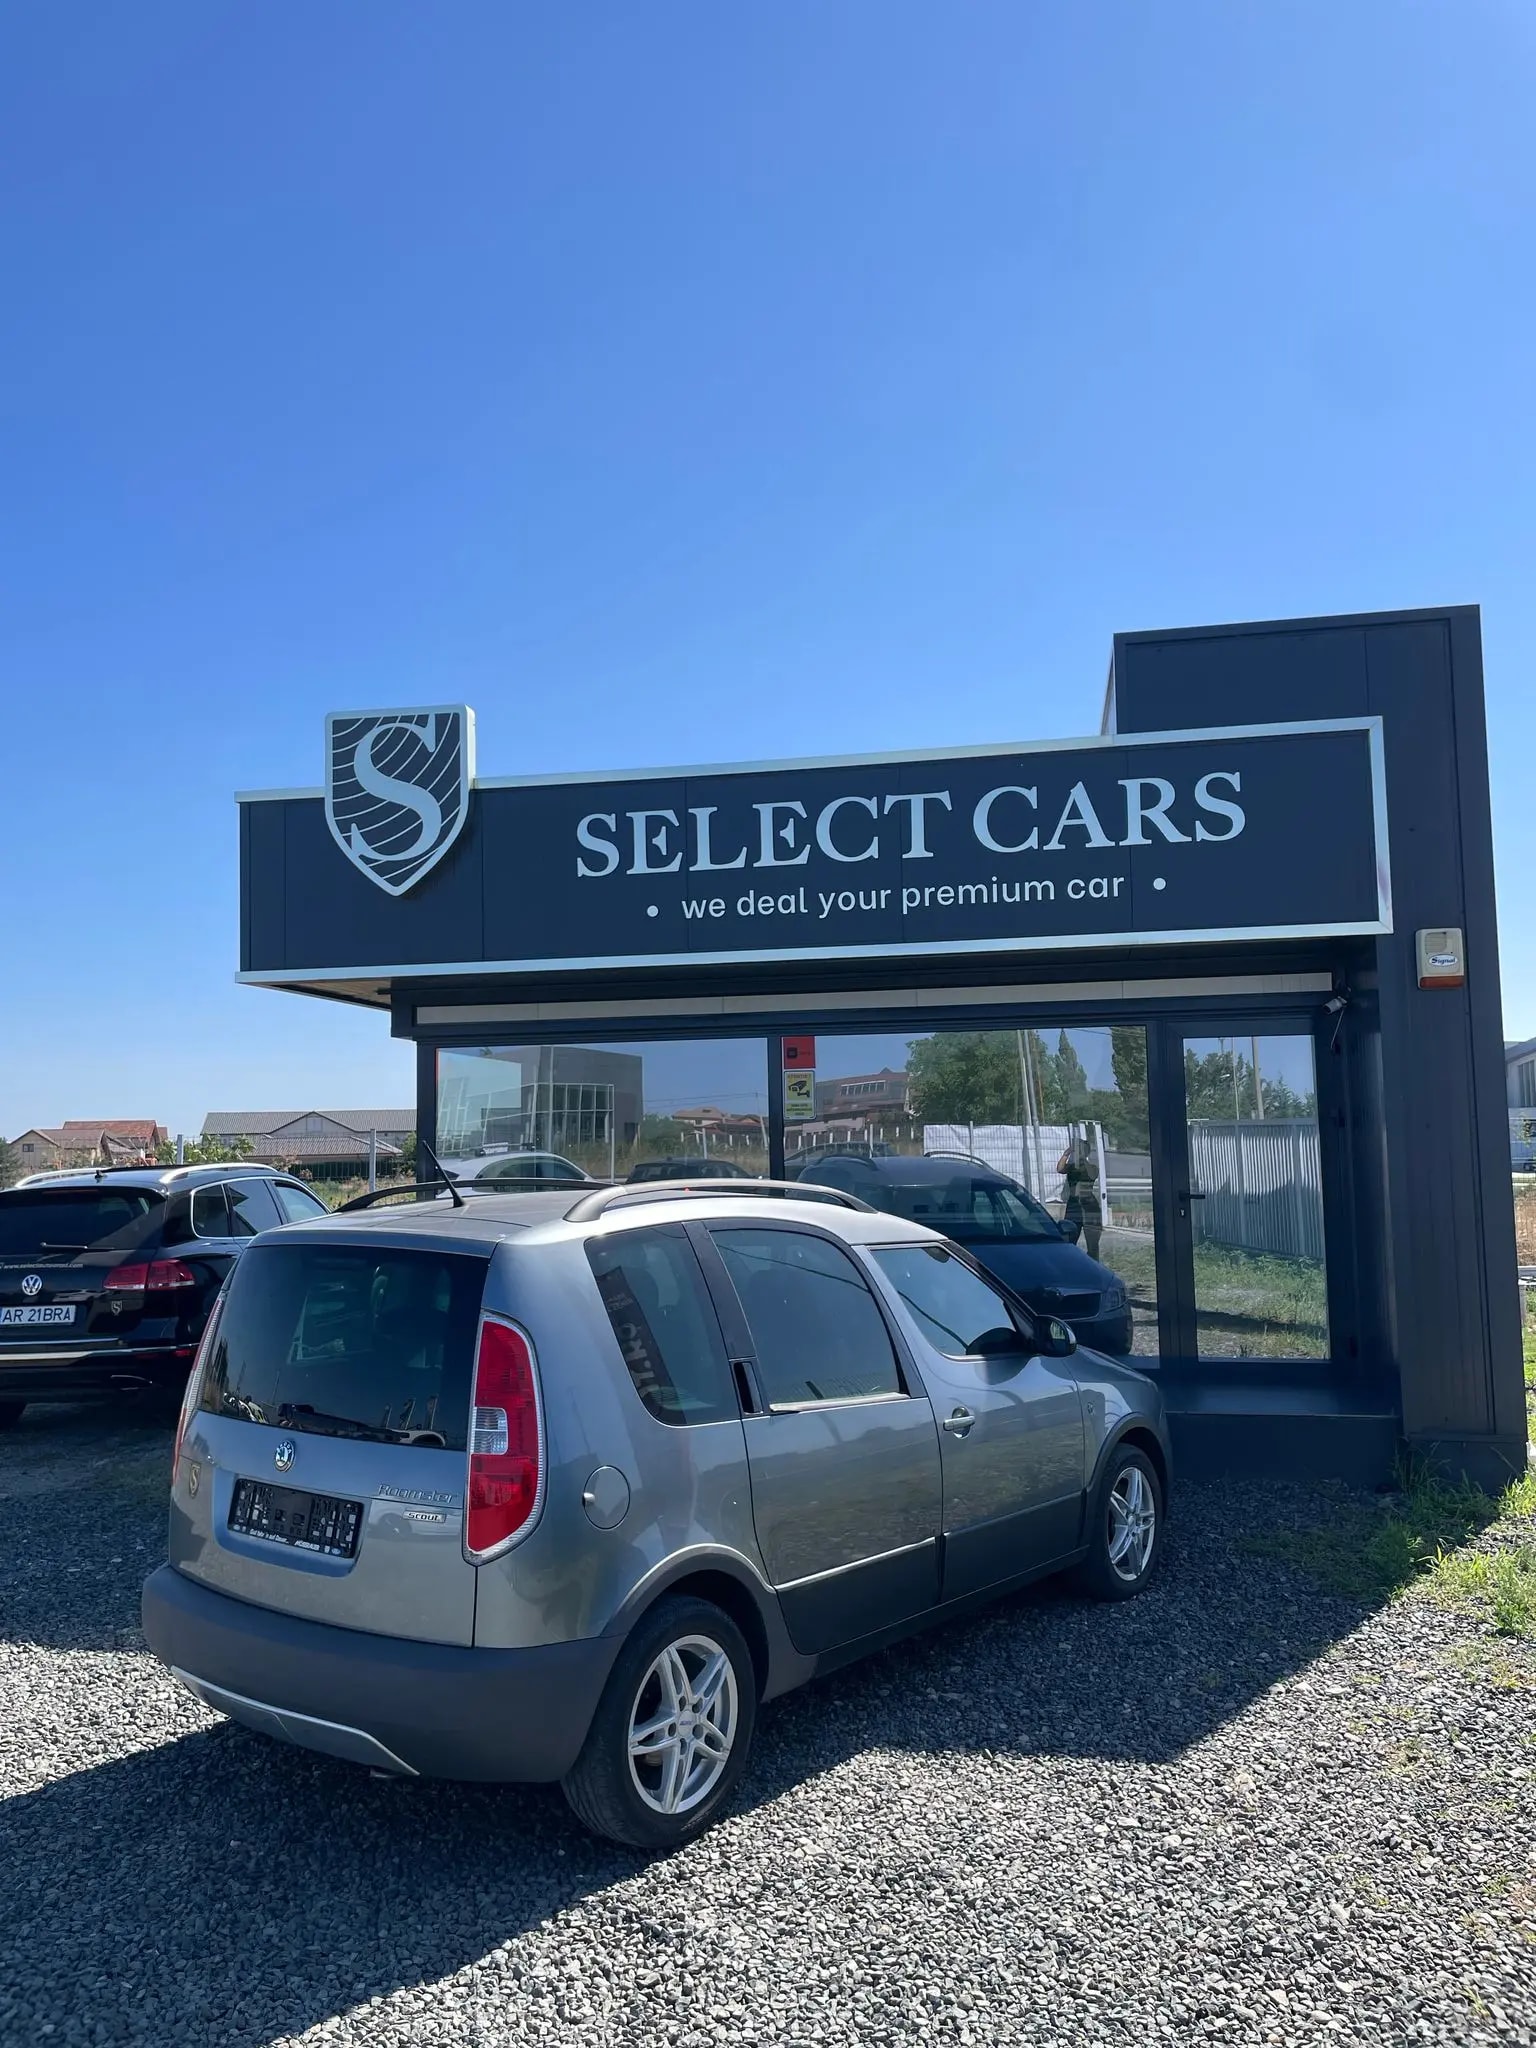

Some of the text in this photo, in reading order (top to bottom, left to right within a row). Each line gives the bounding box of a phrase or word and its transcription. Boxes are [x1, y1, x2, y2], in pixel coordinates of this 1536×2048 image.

[351, 713, 442, 862] S
[576, 771, 1246, 878] SELECT CARS
[681, 875, 1125, 919] we deal your premium car
[3, 1309, 24, 1323] AR
